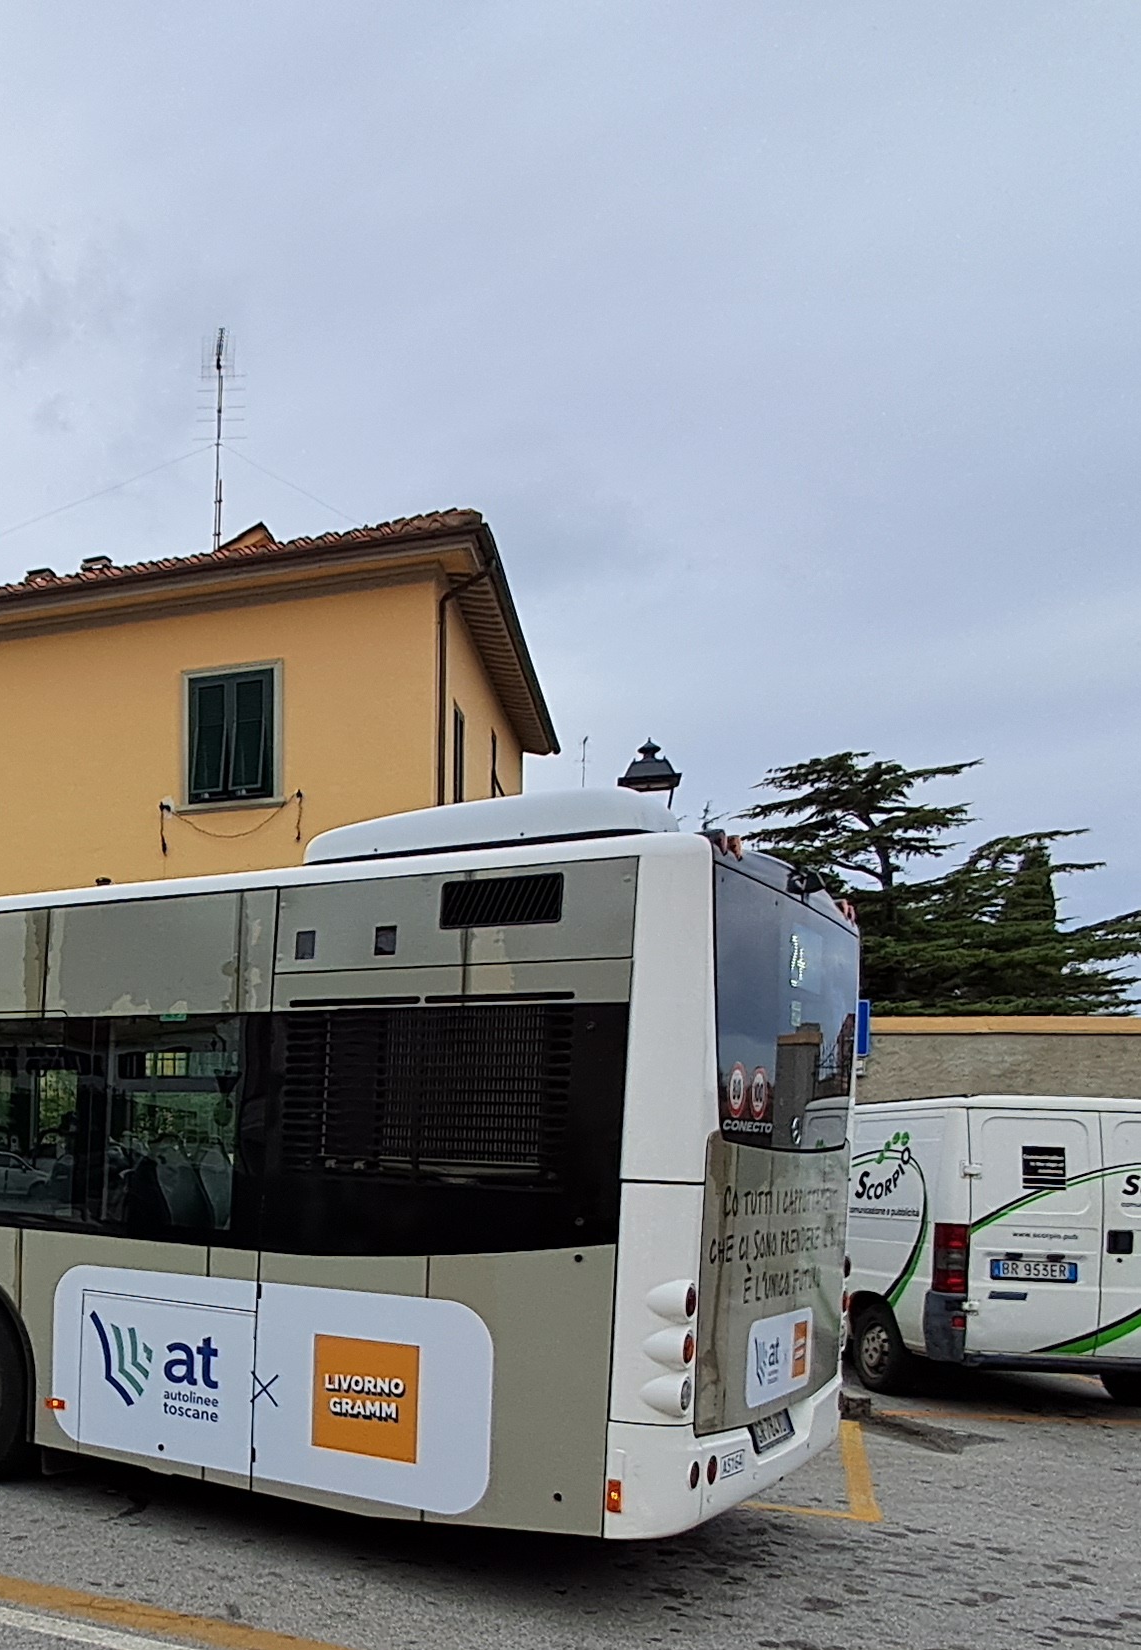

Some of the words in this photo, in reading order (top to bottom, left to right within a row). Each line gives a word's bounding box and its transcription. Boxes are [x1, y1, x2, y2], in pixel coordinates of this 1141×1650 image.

[722, 1119, 773, 1134] CONECTO
[709, 1233, 735, 1265] CHE
[738, 1234, 750, 1261] CI
[1002, 1262, 1019, 1275] BR
[1024, 1263, 1067, 1278] 953ER
[163, 1336, 219, 1389] at
[324, 1373, 405, 1398] LIVORNO
[163, 1390, 219, 1408] autolinee
[329, 1396, 399, 1423] GRAMM
[163, 1402, 219, 1423] toscane
